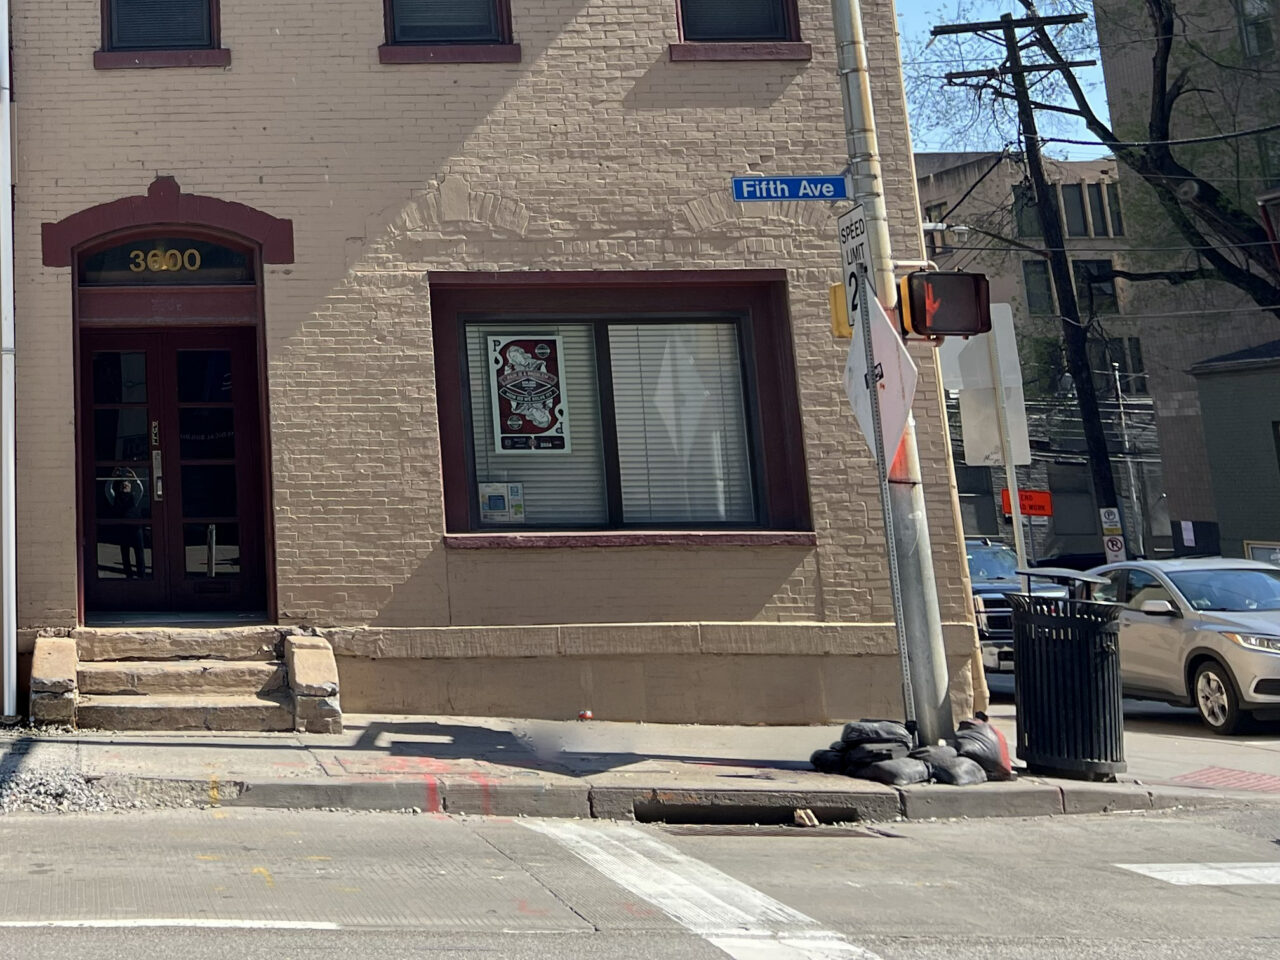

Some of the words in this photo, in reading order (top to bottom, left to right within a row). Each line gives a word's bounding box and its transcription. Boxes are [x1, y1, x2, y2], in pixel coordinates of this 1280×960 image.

[741, 180, 790, 198] Fifth
[799, 180, 835, 197] Ave
[841, 218, 865, 245] SPEED
[128, 248, 202, 272] 3600
[846, 242, 865, 266] LIMIT
[848, 270, 859, 312] 2
